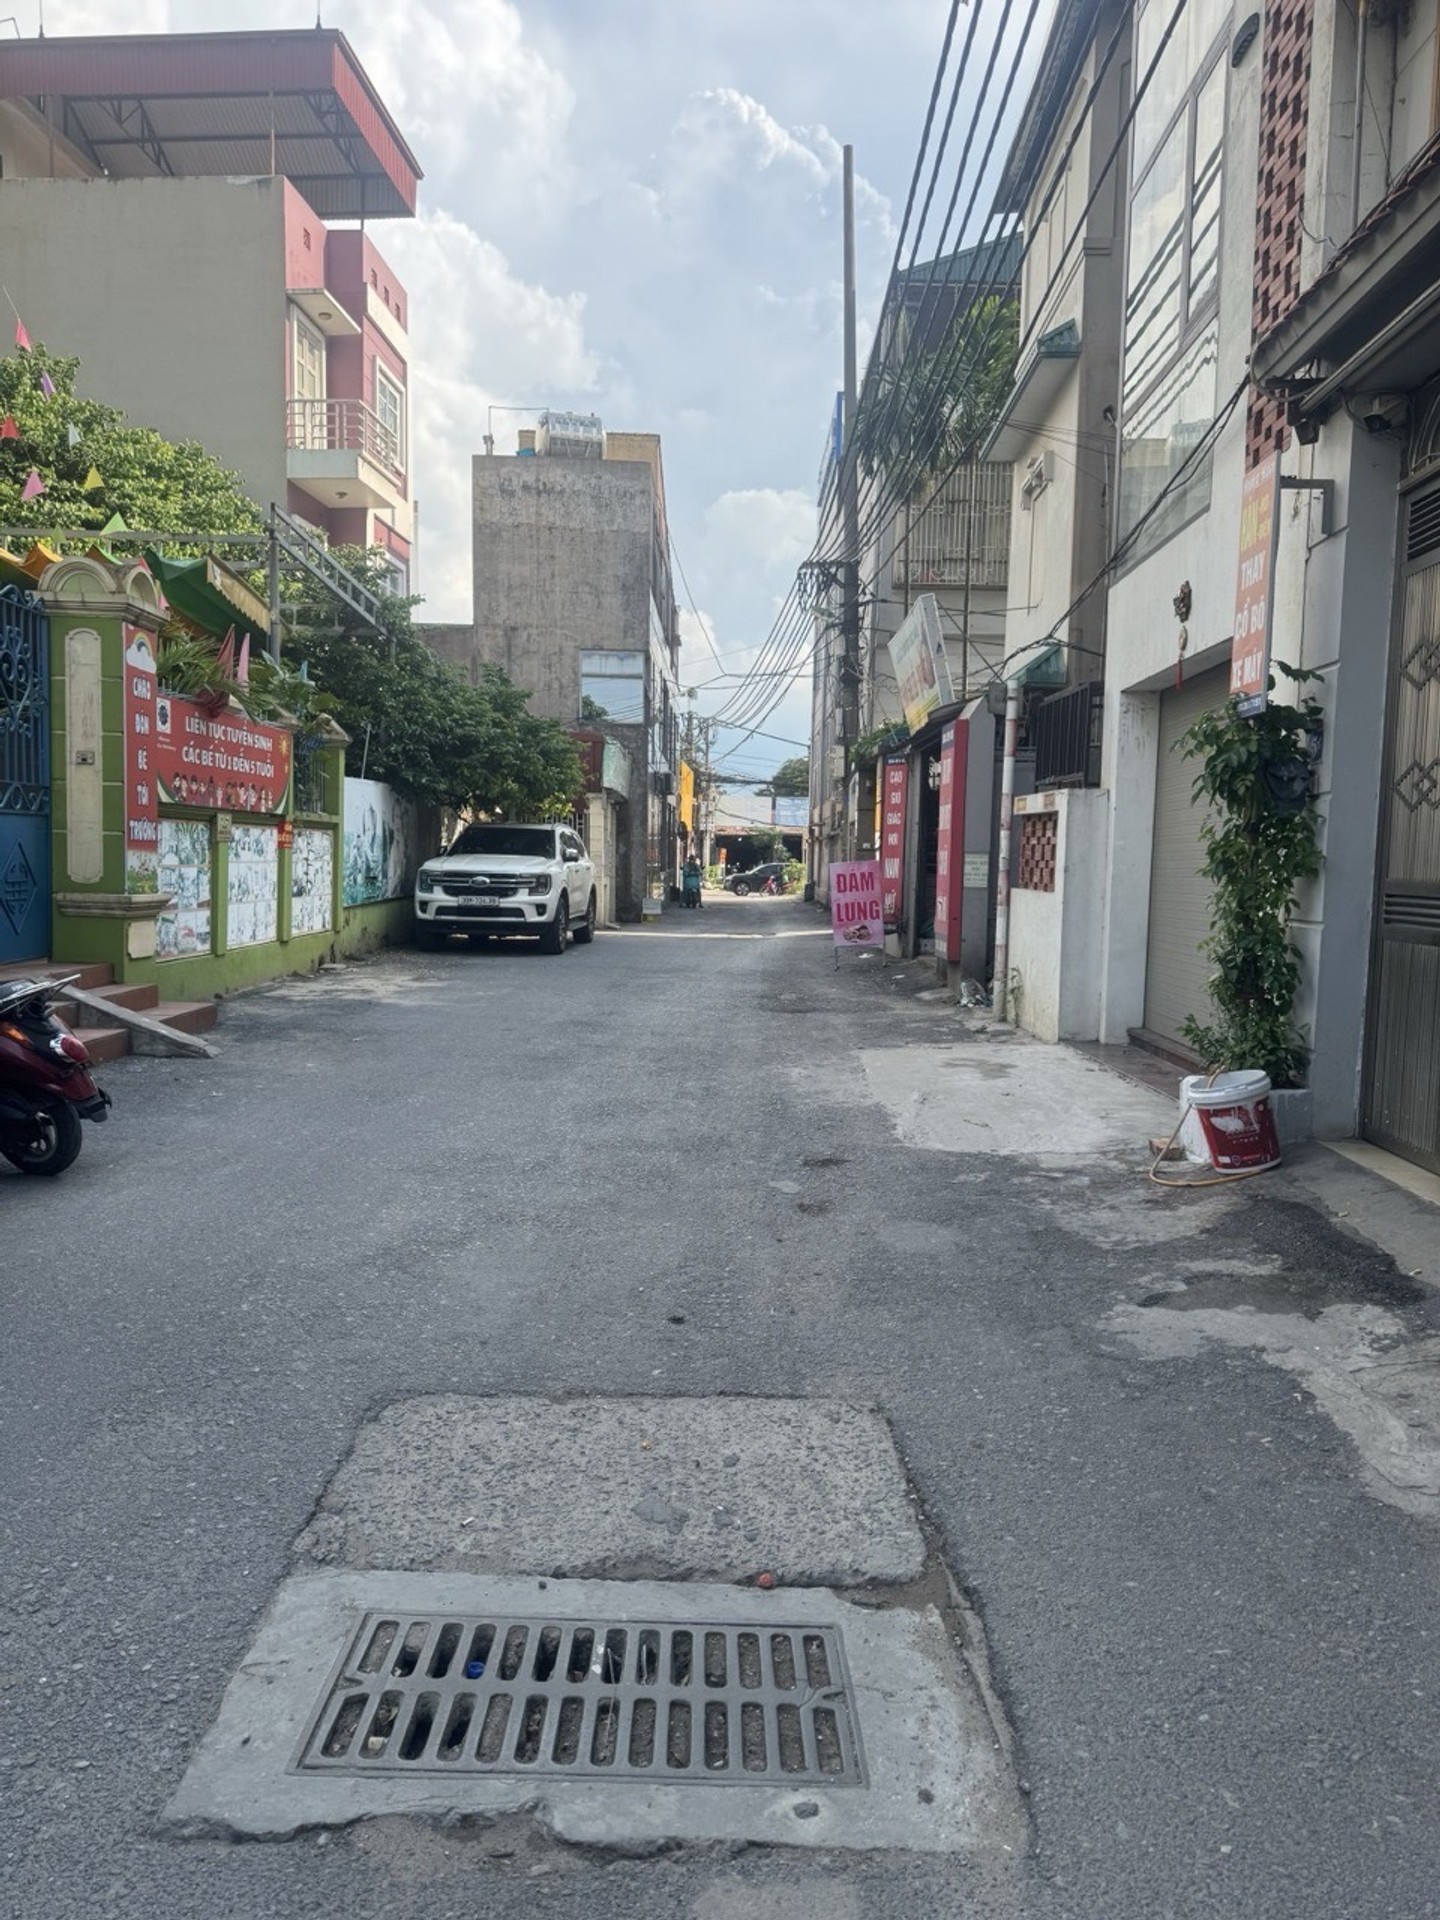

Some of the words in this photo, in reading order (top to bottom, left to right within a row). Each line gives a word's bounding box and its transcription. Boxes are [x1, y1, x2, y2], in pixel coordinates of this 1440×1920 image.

[1241, 550, 1266, 590] THAY
[1243, 647, 1263, 685] MÁY
[185, 711, 207, 736] LIÊN
[208, 722, 226, 743] TỤC
[227, 720, 254, 746] TUYỂN
[254, 734, 273, 752] SINH
[182, 740, 200, 765] CÁC
[201, 745, 214, 768] BÉ
[215, 747, 227, 769] TỪ
[228, 757, 232, 771] 1
[232, 747, 252, 774] ĐẾN
[256, 753, 274, 778] TUỔI
[836, 866, 875, 893] ĐẤM
[884, 858, 899, 879] NAM
[836, 899, 880, 922] LƯNG
